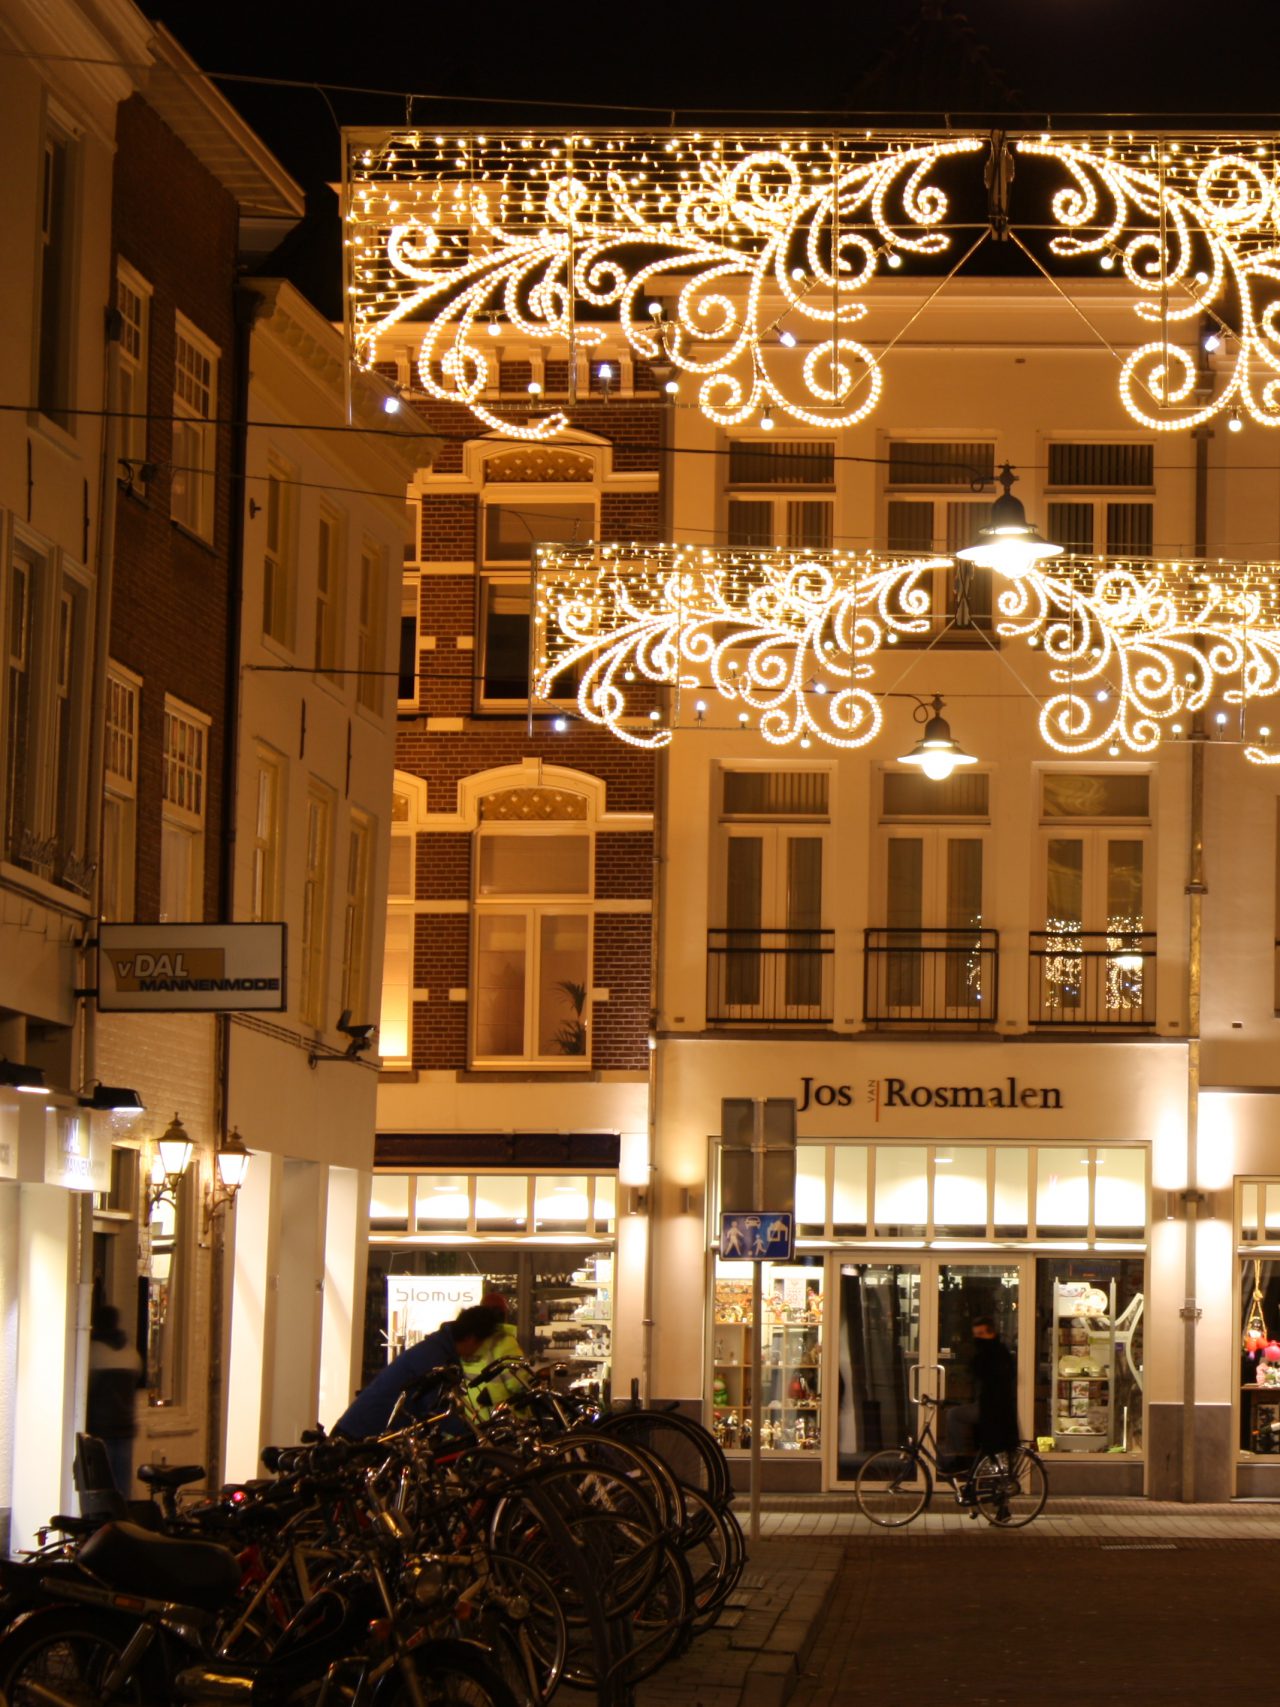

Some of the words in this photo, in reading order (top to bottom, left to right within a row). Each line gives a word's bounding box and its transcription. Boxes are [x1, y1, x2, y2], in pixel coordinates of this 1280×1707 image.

[139, 977, 280, 992] MANNENMODE
[797, 1076, 853, 1112] Jos
[866, 1079, 876, 1103] VAN
[883, 1076, 1064, 1110] Rosmalen
[395, 1288, 474, 1303] blomus
